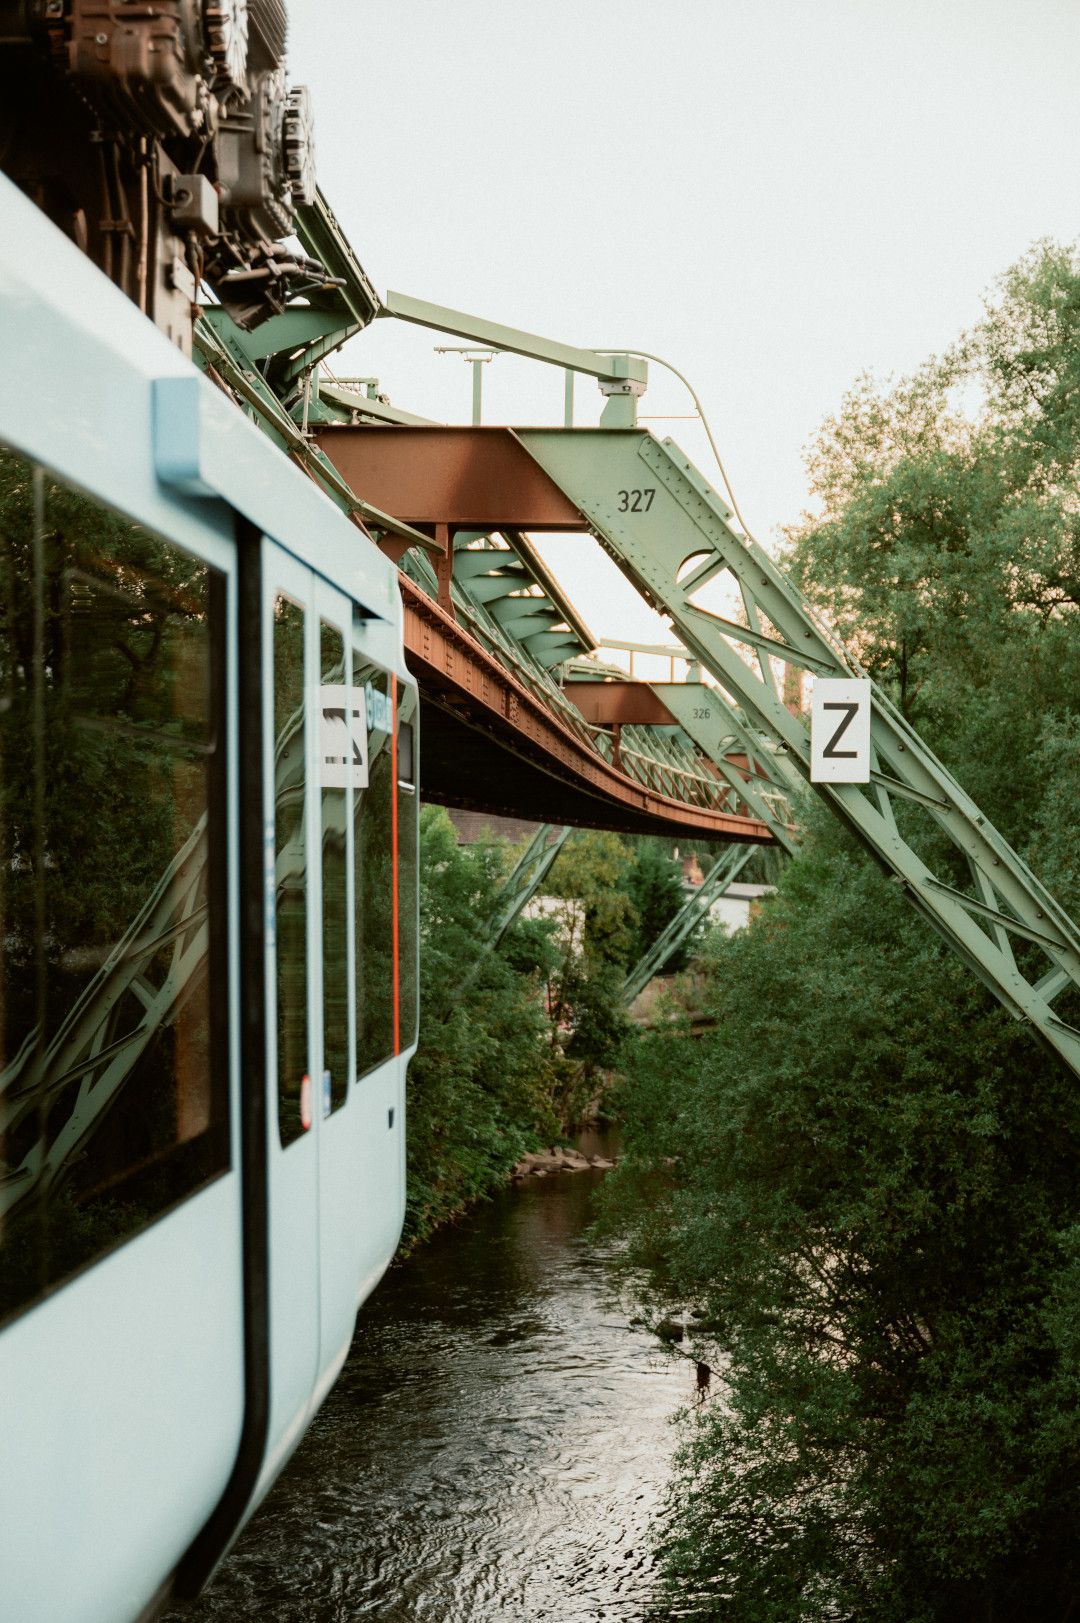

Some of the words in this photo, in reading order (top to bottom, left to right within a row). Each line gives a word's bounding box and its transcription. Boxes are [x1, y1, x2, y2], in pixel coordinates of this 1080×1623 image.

[617, 488, 656, 512] 327
[693, 708, 711, 719] 326
[822, 702, 859, 758] Z
